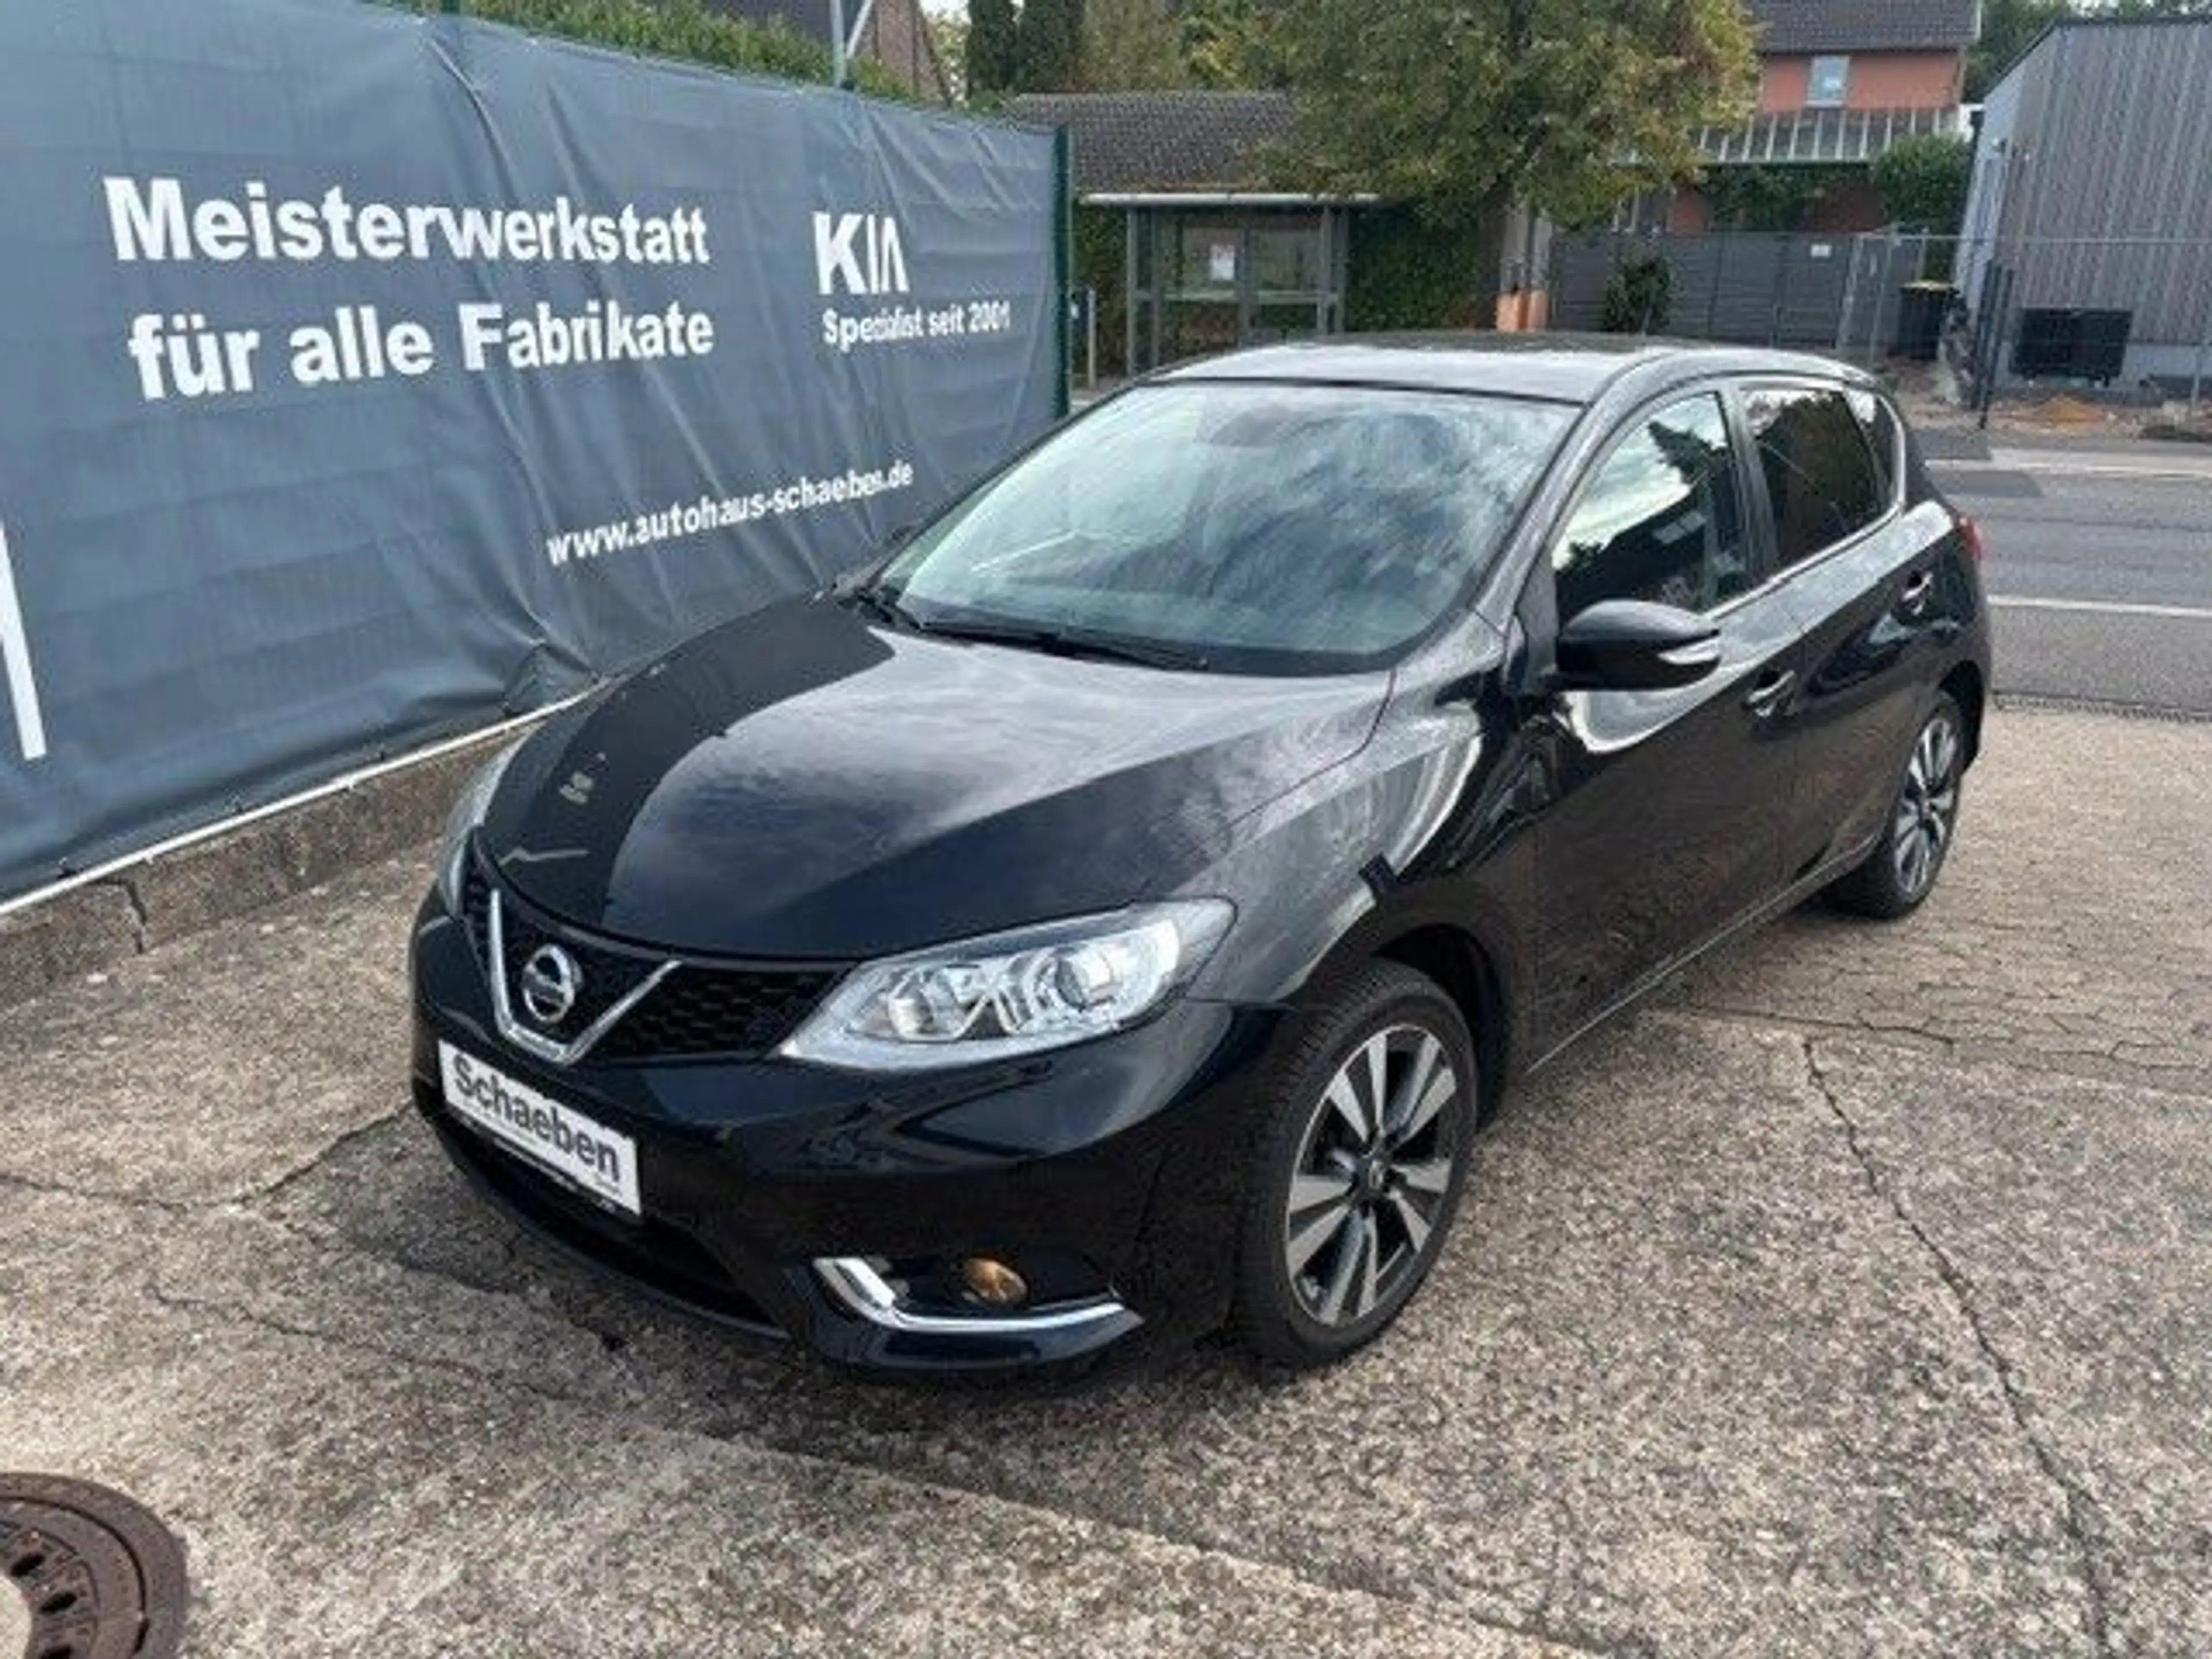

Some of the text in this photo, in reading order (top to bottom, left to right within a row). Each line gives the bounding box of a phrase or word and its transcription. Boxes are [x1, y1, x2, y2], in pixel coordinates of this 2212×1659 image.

[103, 177, 710, 264] Meisterwerkstatt
[814, 211, 910, 296] KIA
[128, 300, 714, 400] für alle Fabrikate
[929, 303, 965, 337] seit
[452, 1052, 622, 1183] Schaeben
